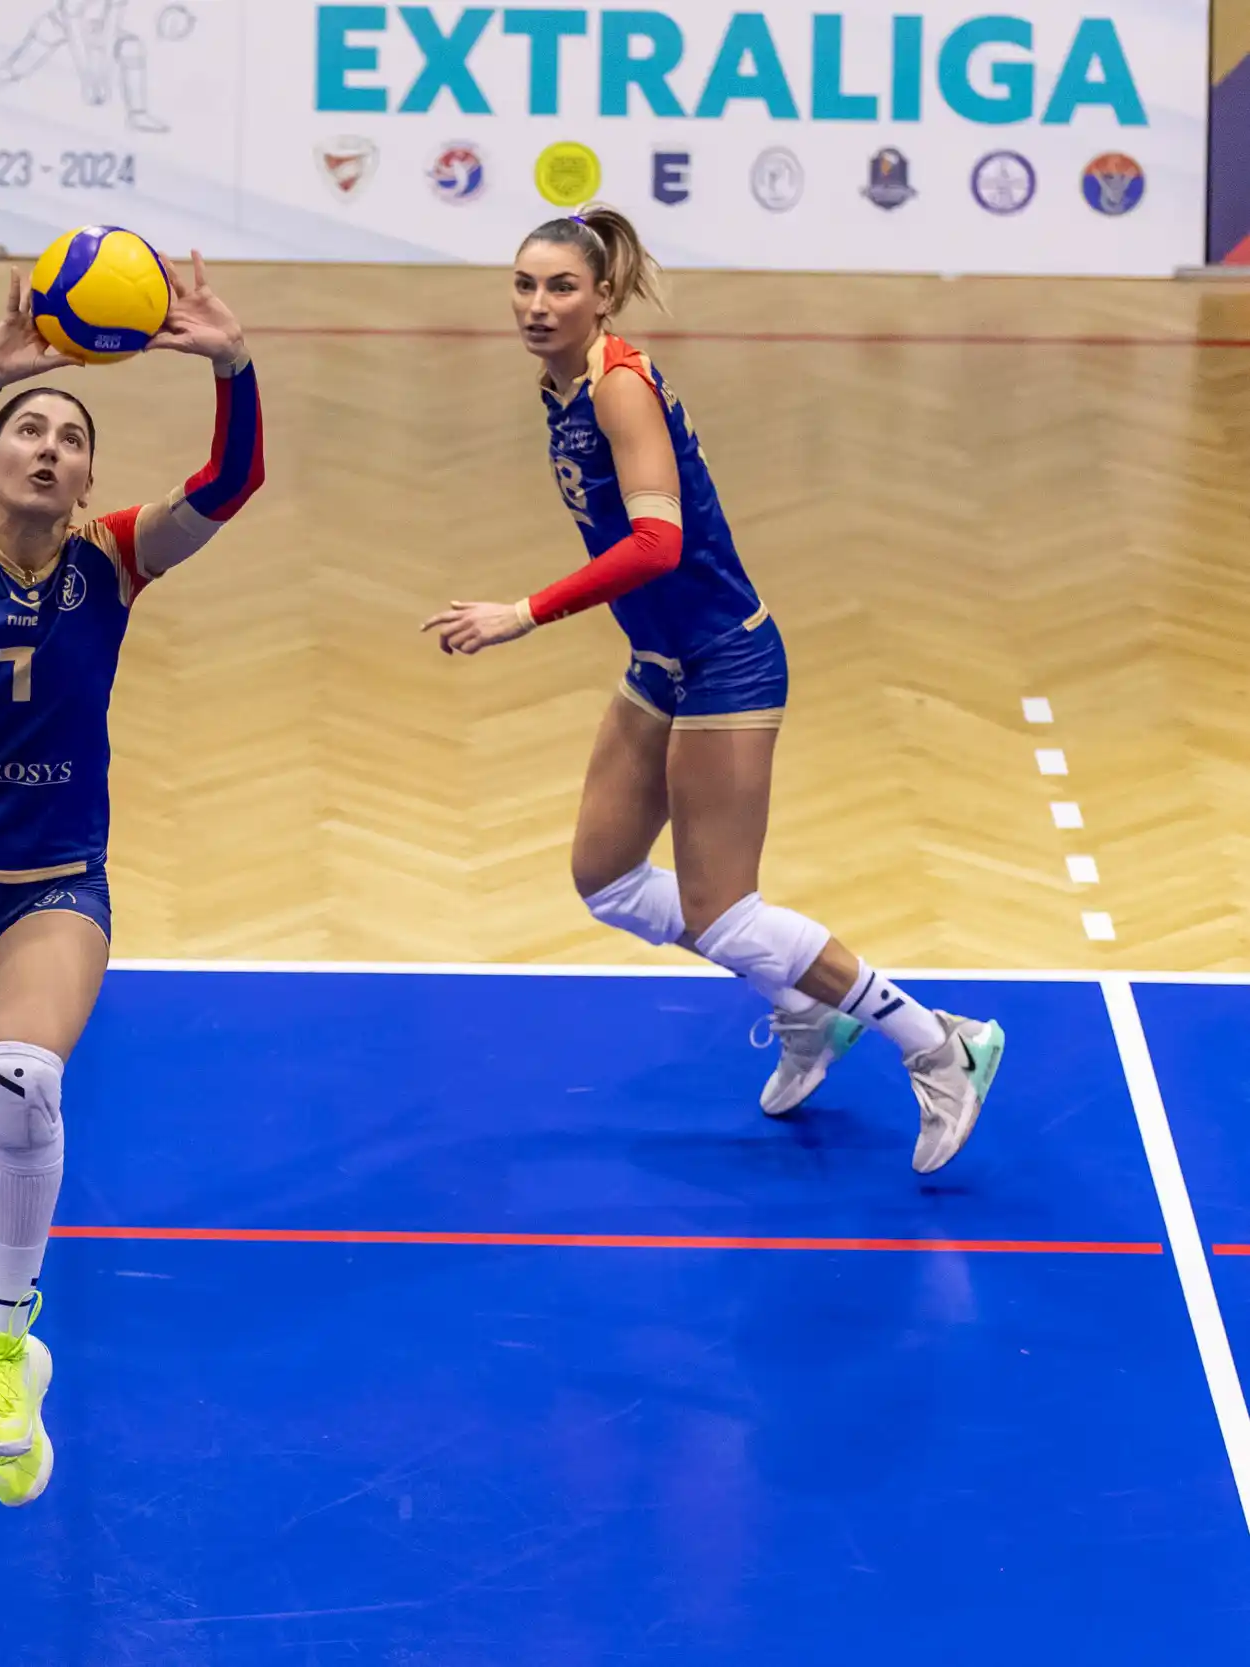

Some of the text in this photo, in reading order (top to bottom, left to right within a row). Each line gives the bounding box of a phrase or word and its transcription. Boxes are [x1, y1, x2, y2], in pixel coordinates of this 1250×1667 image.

[313, 4, 1150, 127] EXTRALIGA
[59, 152, 136, 189] 2024
[7, 613, 39, 626] nine
